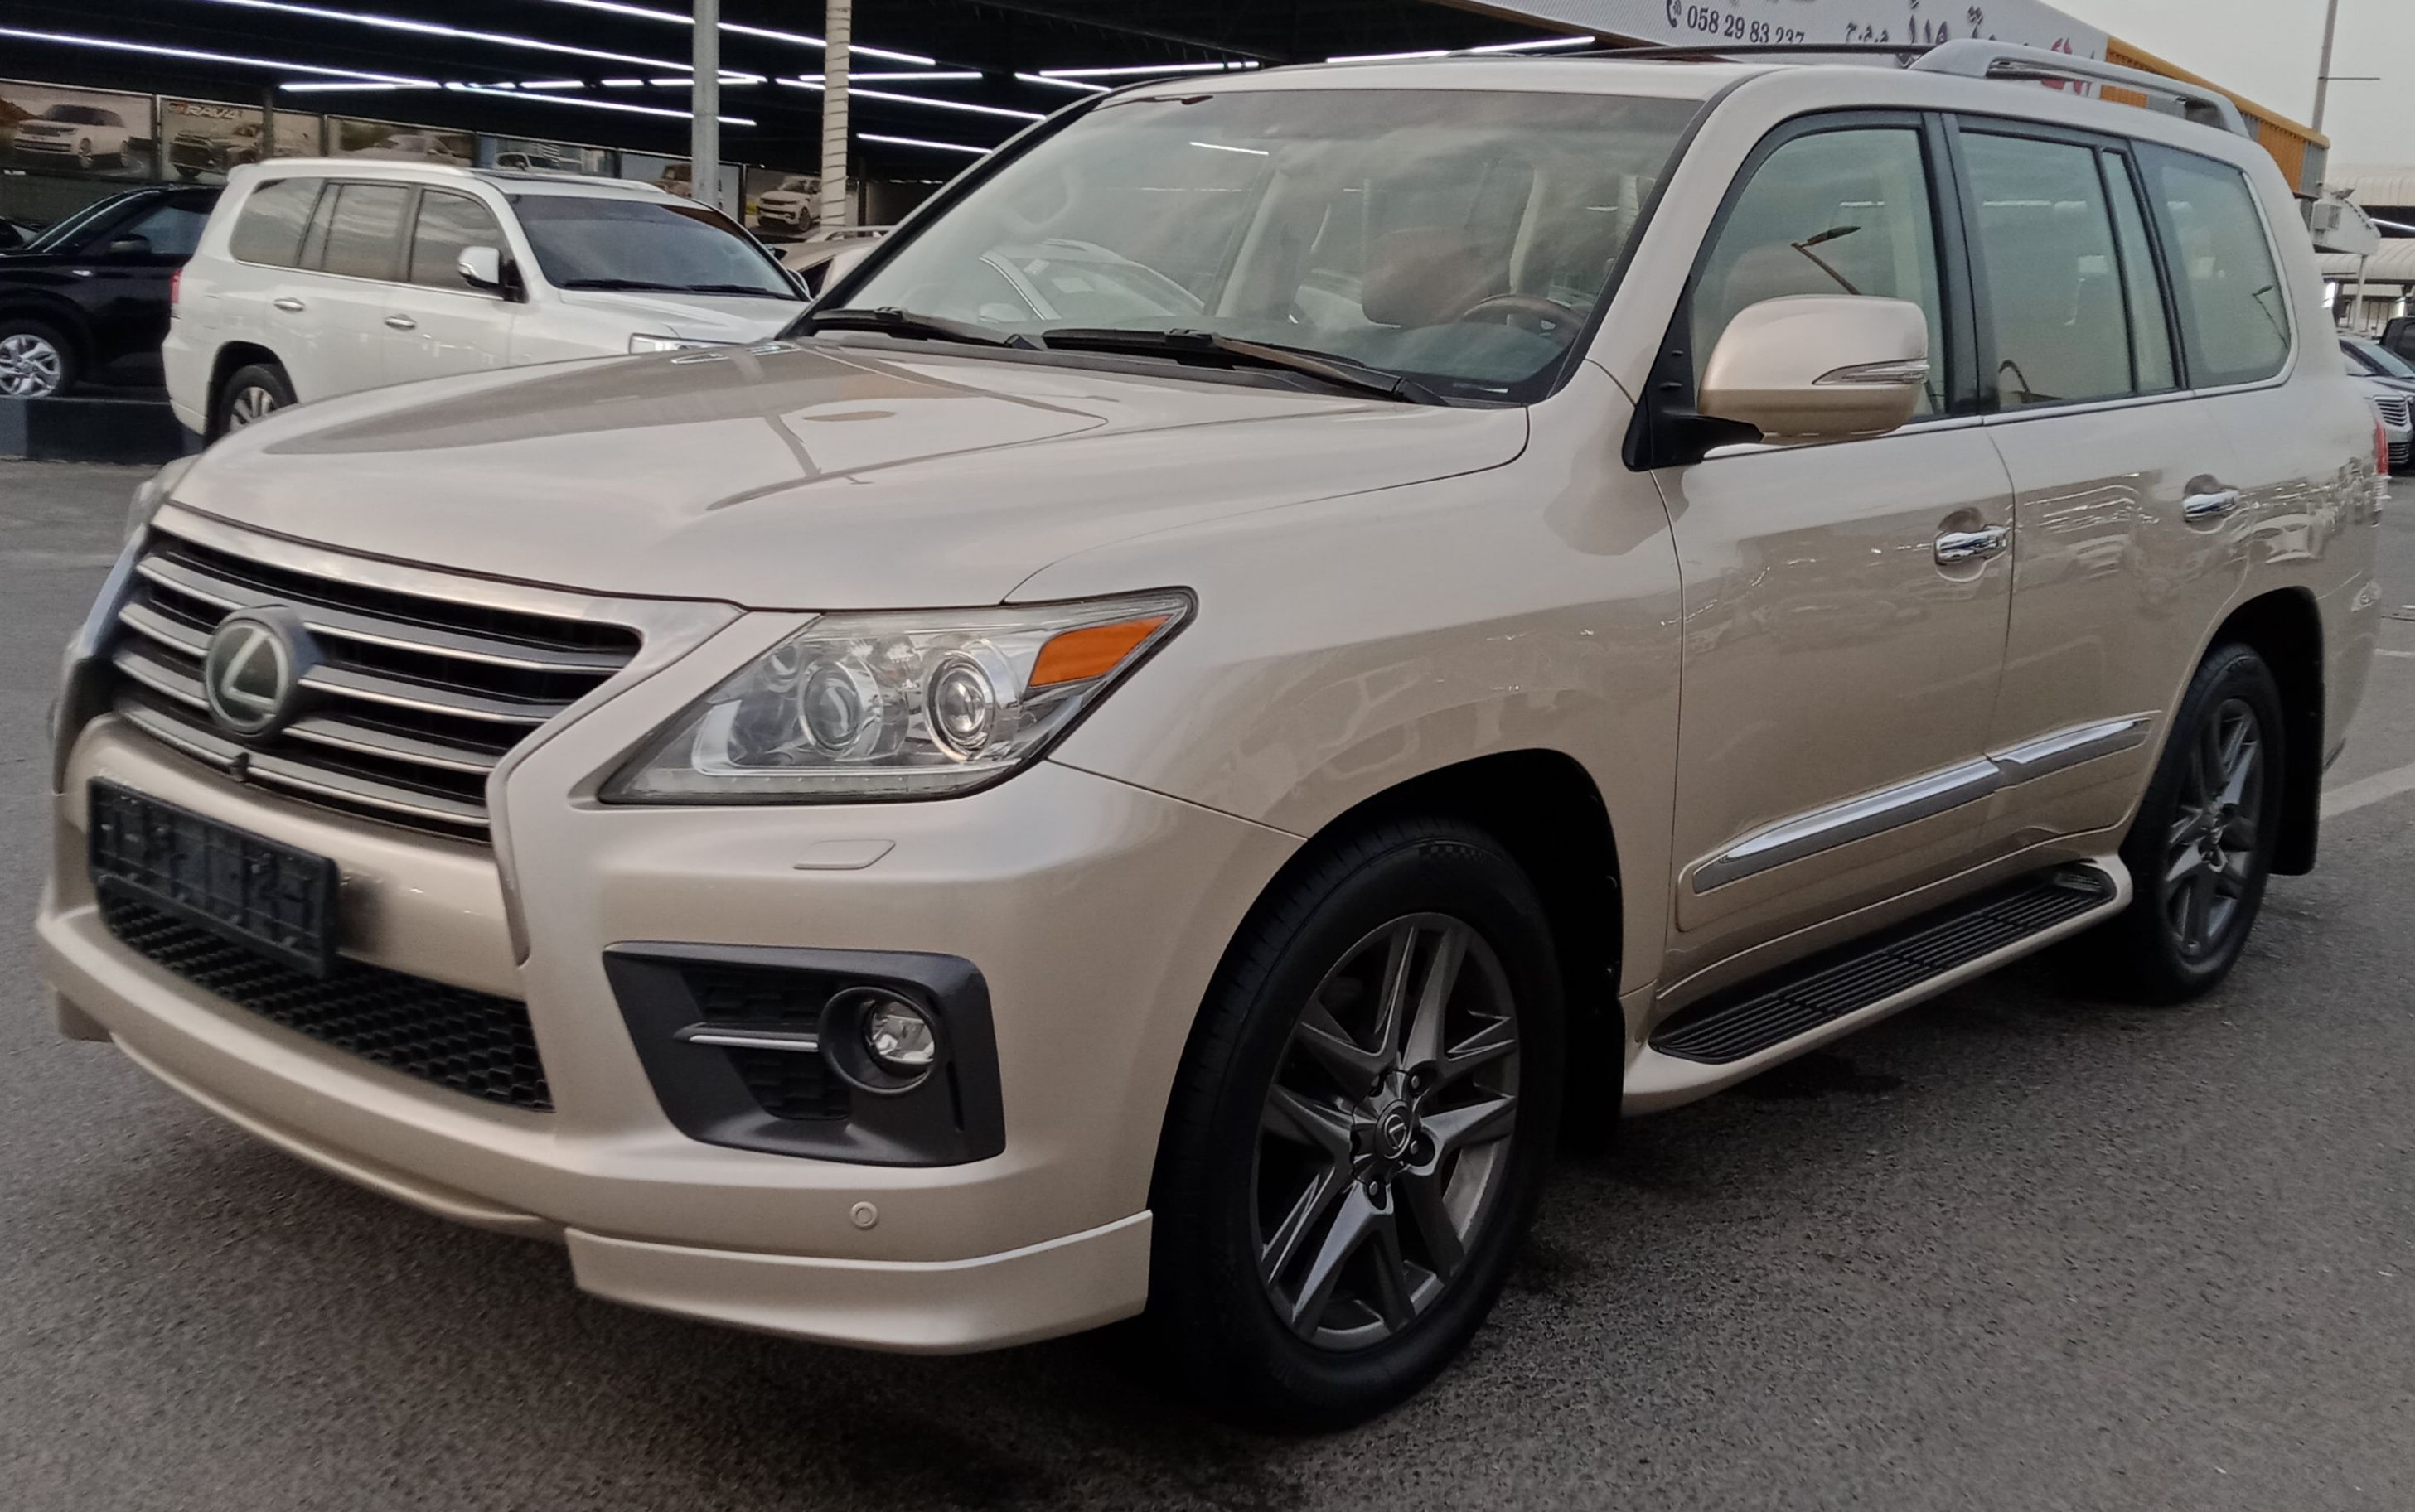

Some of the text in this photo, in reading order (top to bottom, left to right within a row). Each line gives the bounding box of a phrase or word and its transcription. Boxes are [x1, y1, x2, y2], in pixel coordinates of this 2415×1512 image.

[1687, 5, 1720, 34] 058
[1724, 14, 1745, 40] 29
[1750, 21, 1769, 43] 83
